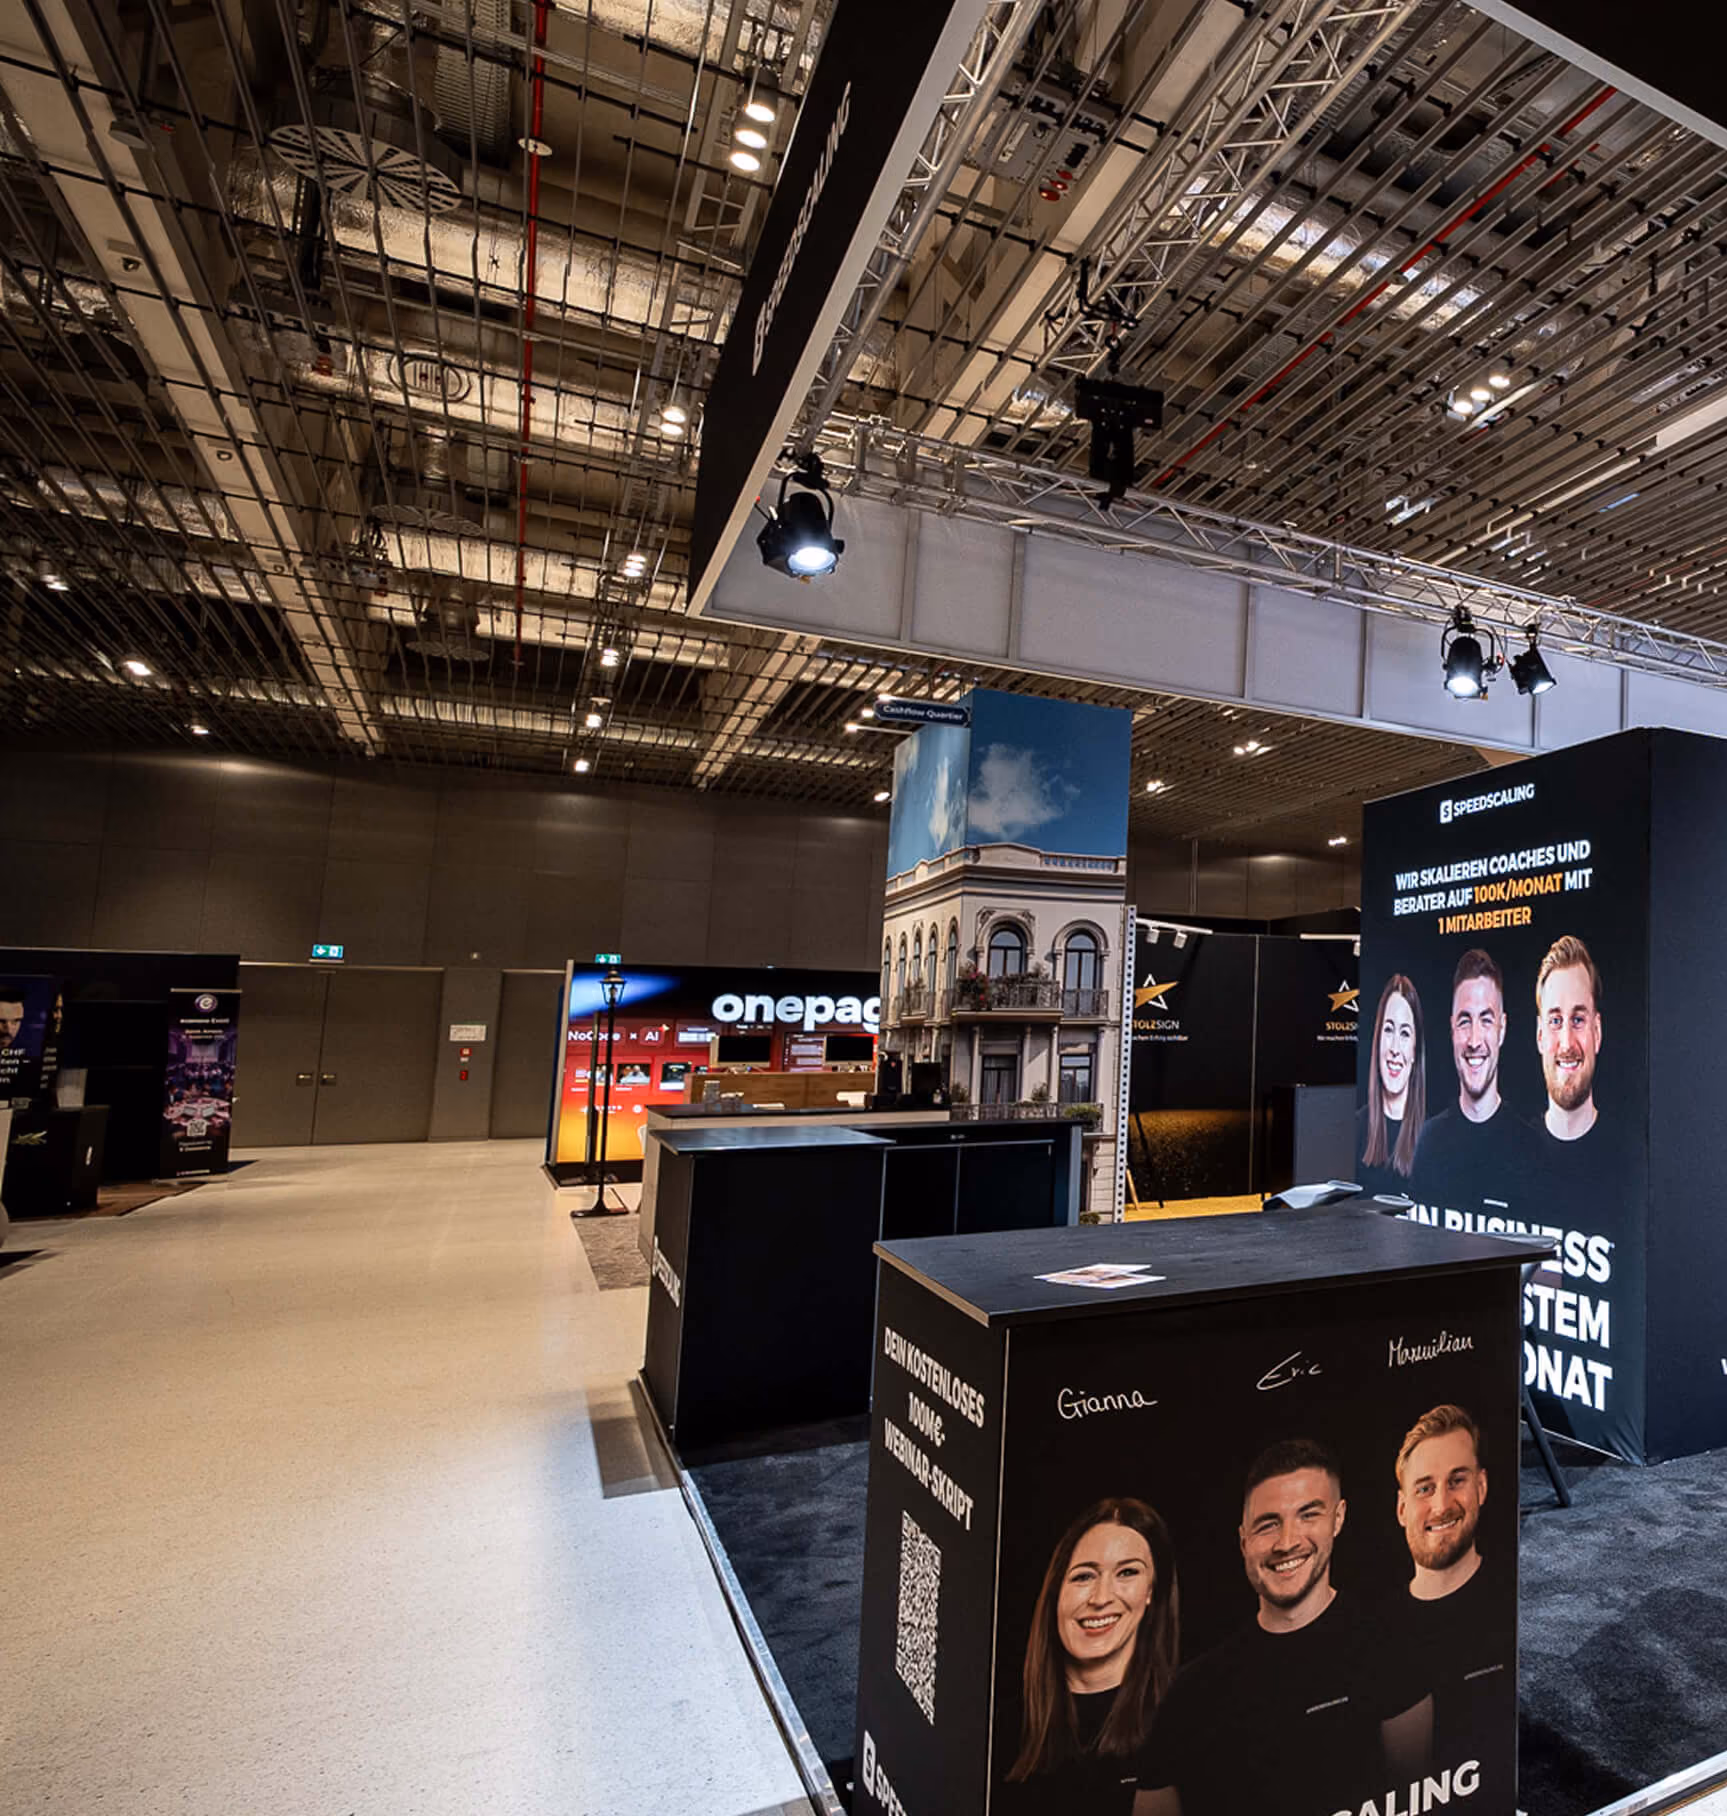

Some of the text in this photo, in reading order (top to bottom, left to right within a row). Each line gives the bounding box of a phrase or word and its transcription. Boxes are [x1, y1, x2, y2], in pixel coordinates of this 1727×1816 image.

[882, 704, 963, 721] Cashflow Quartier
[1453, 783, 1535, 817] SPEEDSCALING
[1395, 839, 1591, 891] WIR SKALIEREN COACHES UND
[1393, 868, 1593, 916] BERATER AUF 100K/MONAT MIT
[1438, 906, 1532, 935] 1 MITARBEITER
[712, 993, 880, 1034] onepag
[1132, 1019, 1180, 1030] TOLZSIGN
[645, 1031, 659, 1041] AI
[884, 1326, 985, 1428] DEIN KOSTENLOSES
[1057, 1387, 1158, 1420] Gianna
[1256, 1351, 1324, 1391] Eric
[884, 1417, 974, 1531] WEBINAR-SKRIPT
[1331, 1759, 1480, 1816] ALING
